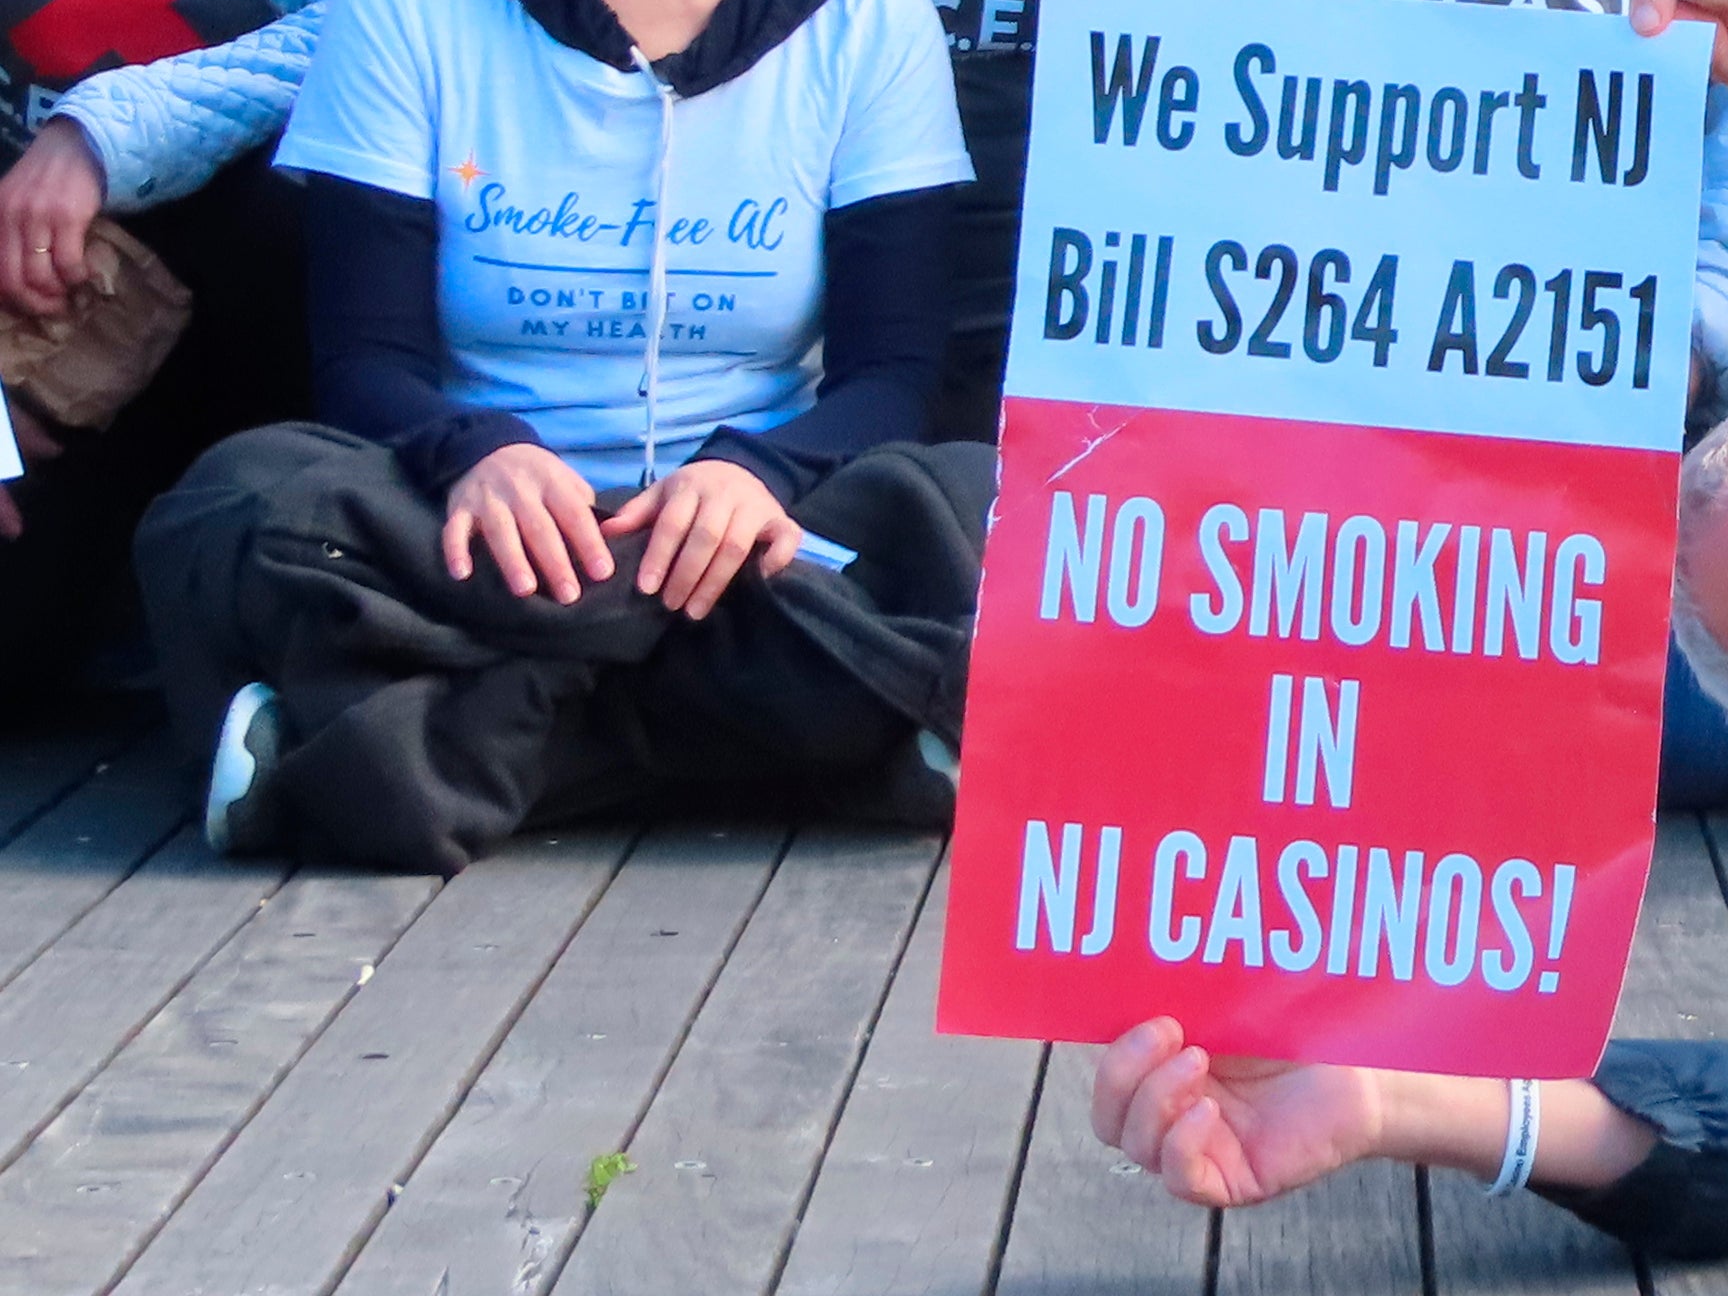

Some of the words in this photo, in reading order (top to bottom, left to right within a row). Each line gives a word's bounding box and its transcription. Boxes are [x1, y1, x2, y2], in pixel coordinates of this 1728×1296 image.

[1089, 31, 1200, 152] We
[1225, 42, 1545, 197] Support
[1570, 68, 1655, 188] NJ
[465, 183, 713, 247] Smoke-Fee
[508, 286, 604, 310] DON'T
[692, 294, 735, 311] ON
[521, 319, 569, 336] MY
[588, 320, 706, 340] HEATH
[1042, 228, 1175, 349] Bill
[1197, 240, 1399, 369] S264
[1427, 259, 1659, 391] A2151
[1039, 489, 1166, 629] NO
[1190, 500, 1606, 666] SMOKING
[1261, 673, 1360, 810] IN
[1014, 818, 1123, 956] NJ
[1148, 829, 1577, 996] CASINOS!
